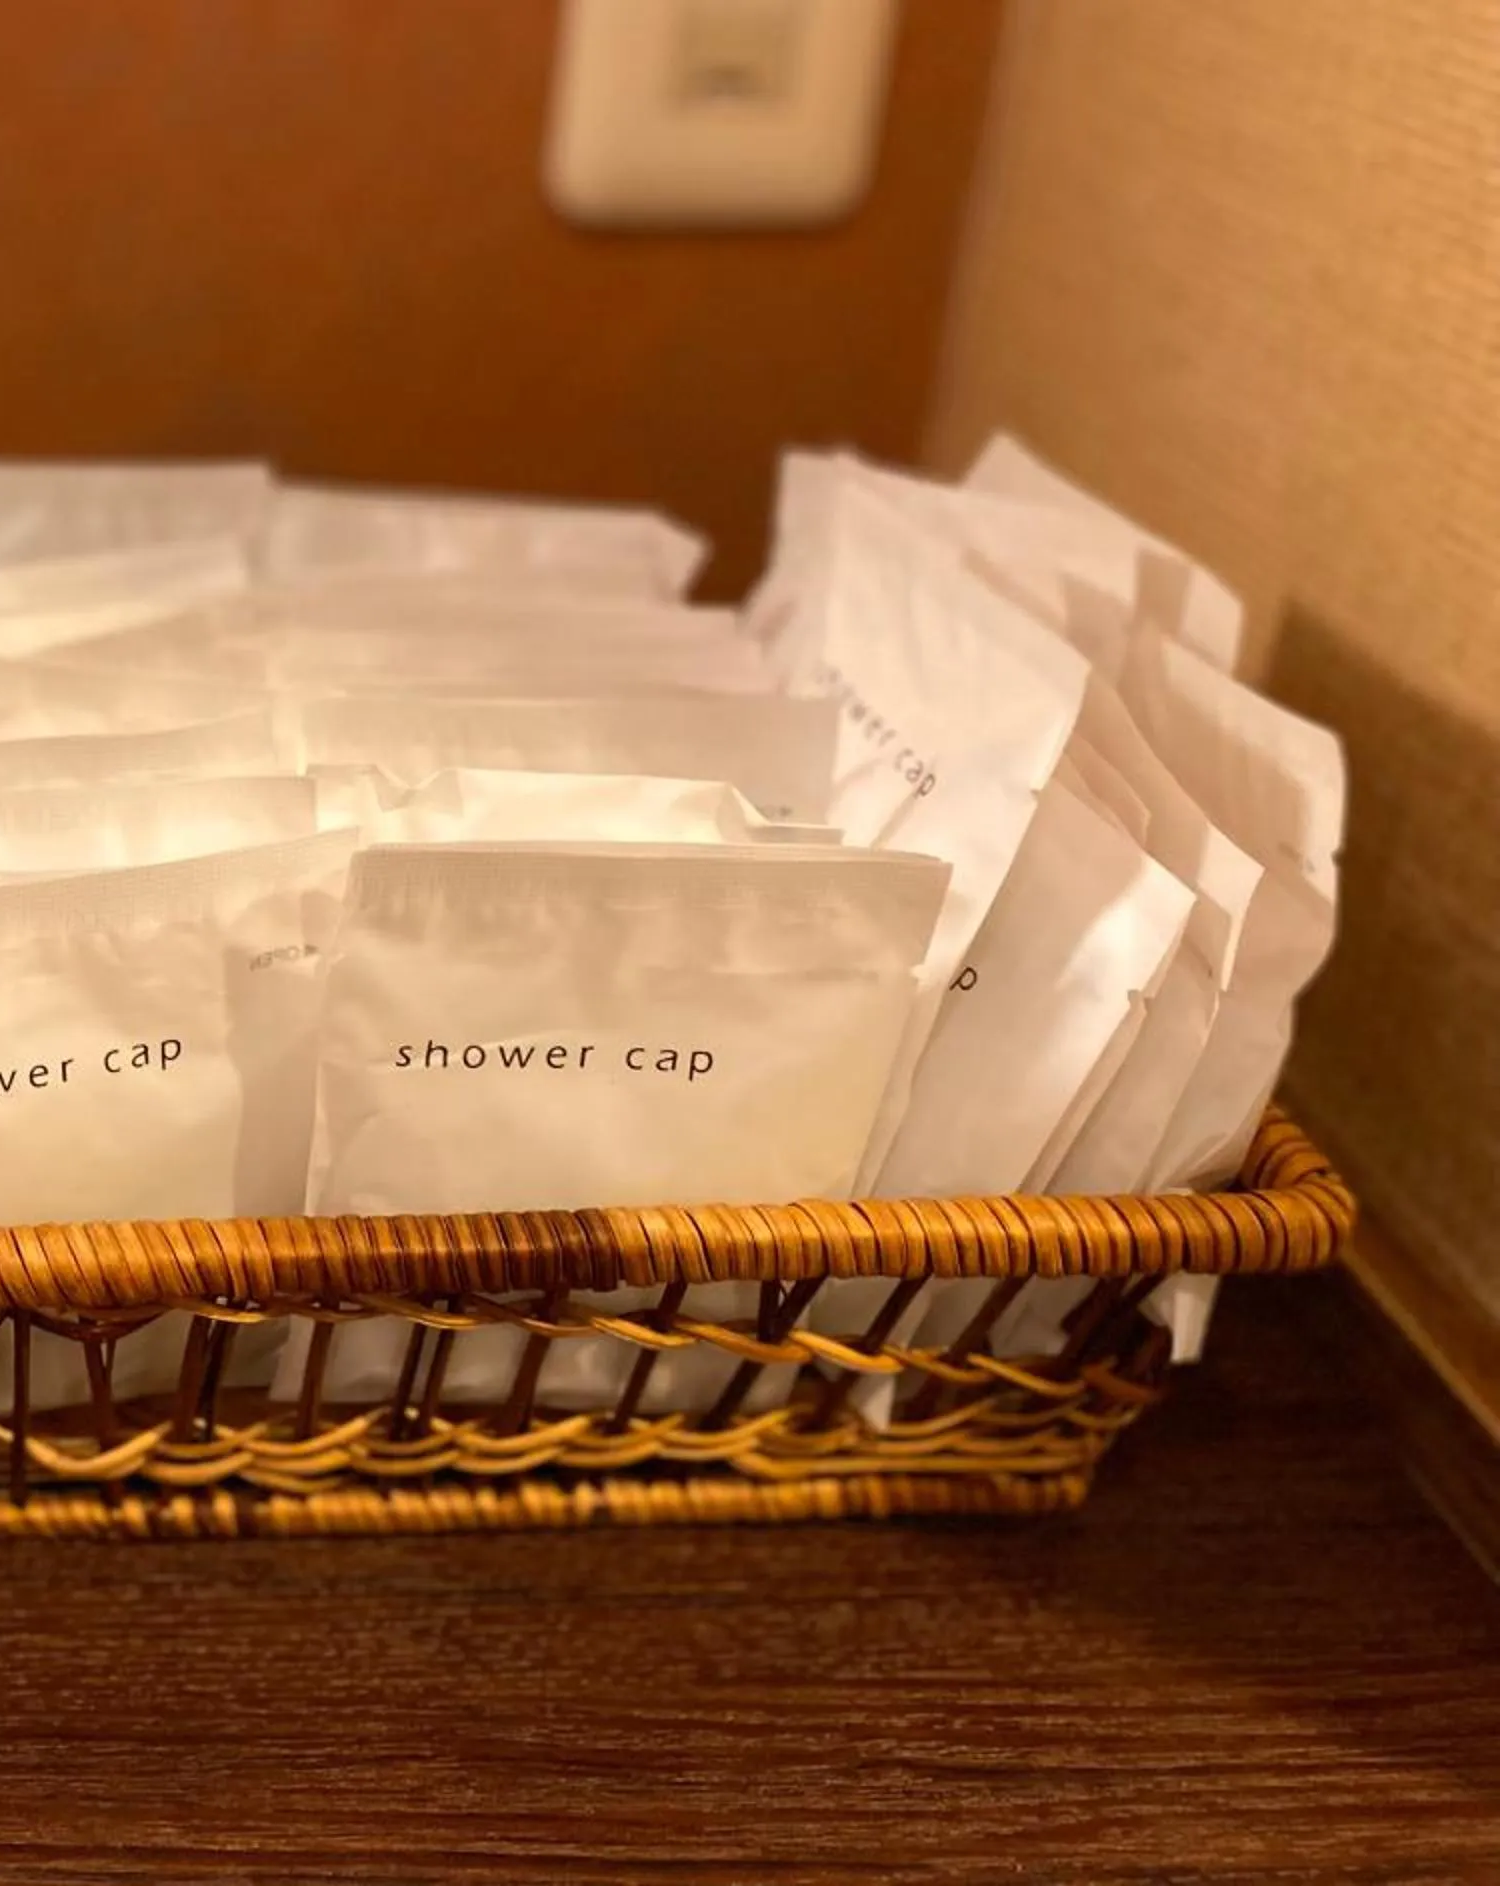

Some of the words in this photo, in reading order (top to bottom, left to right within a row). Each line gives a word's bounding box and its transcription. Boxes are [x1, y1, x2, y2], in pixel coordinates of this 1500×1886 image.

[894, 748, 936, 800] cap
[103, 1037, 182, 1074] cap
[395, 1039, 595, 1070] shower
[625, 1045, 714, 1082] cap
